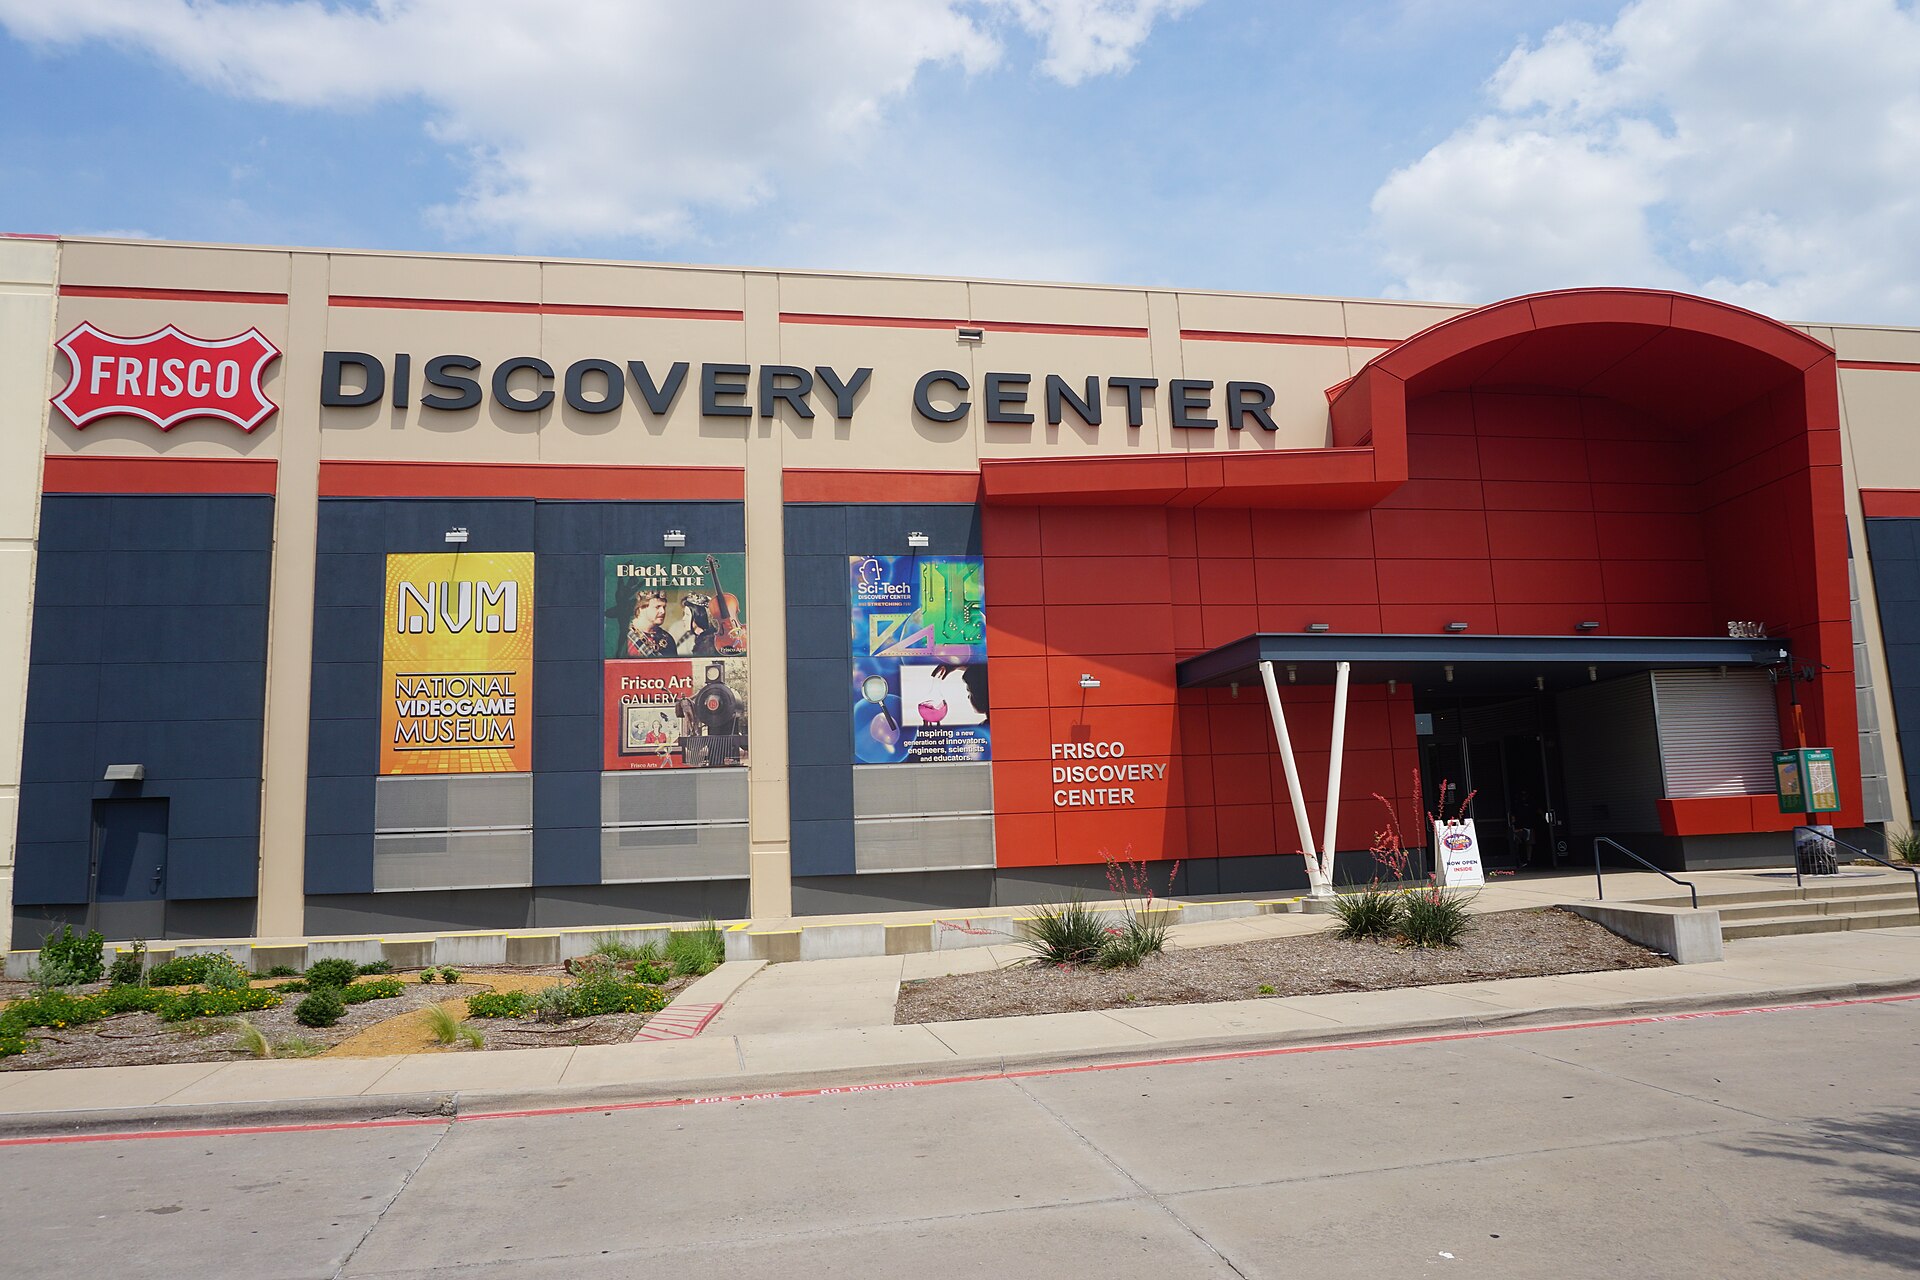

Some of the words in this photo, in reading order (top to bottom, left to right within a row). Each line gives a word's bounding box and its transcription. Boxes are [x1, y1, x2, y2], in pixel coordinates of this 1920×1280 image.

[89, 355, 241, 400] FRISCO
[321, 351, 873, 420] DISCOVERY
[914, 369, 1279, 432] CENTER
[617, 564, 668, 577] Black
[671, 563, 705, 576] Box
[644, 577, 705, 587] THEATRE
[857, 581, 911, 594] Sci-Tech
[395, 677, 516, 698] NATIONAL
[621, 676, 664, 690] Frisco
[668, 675, 692, 689] Art
[621, 693, 678, 705] GALLERY
[396, 698, 516, 717] VIDEOGAME
[394, 717, 515, 743] MUSEUM
[916, 729, 954, 738] Inspiring
[903, 739, 937, 747] generation
[946, 737, 988, 745] innovators,
[908, 747, 947, 755] engineers,
[948, 745, 985, 753] scientists
[1051, 741, 1125, 760] FRISCO
[1052, 763, 1167, 783] DISCOVERY
[1054, 787, 1135, 807] CENTER
[849, 1081, 915, 1093] PARKING
[741, 1091, 784, 1100] LANE
